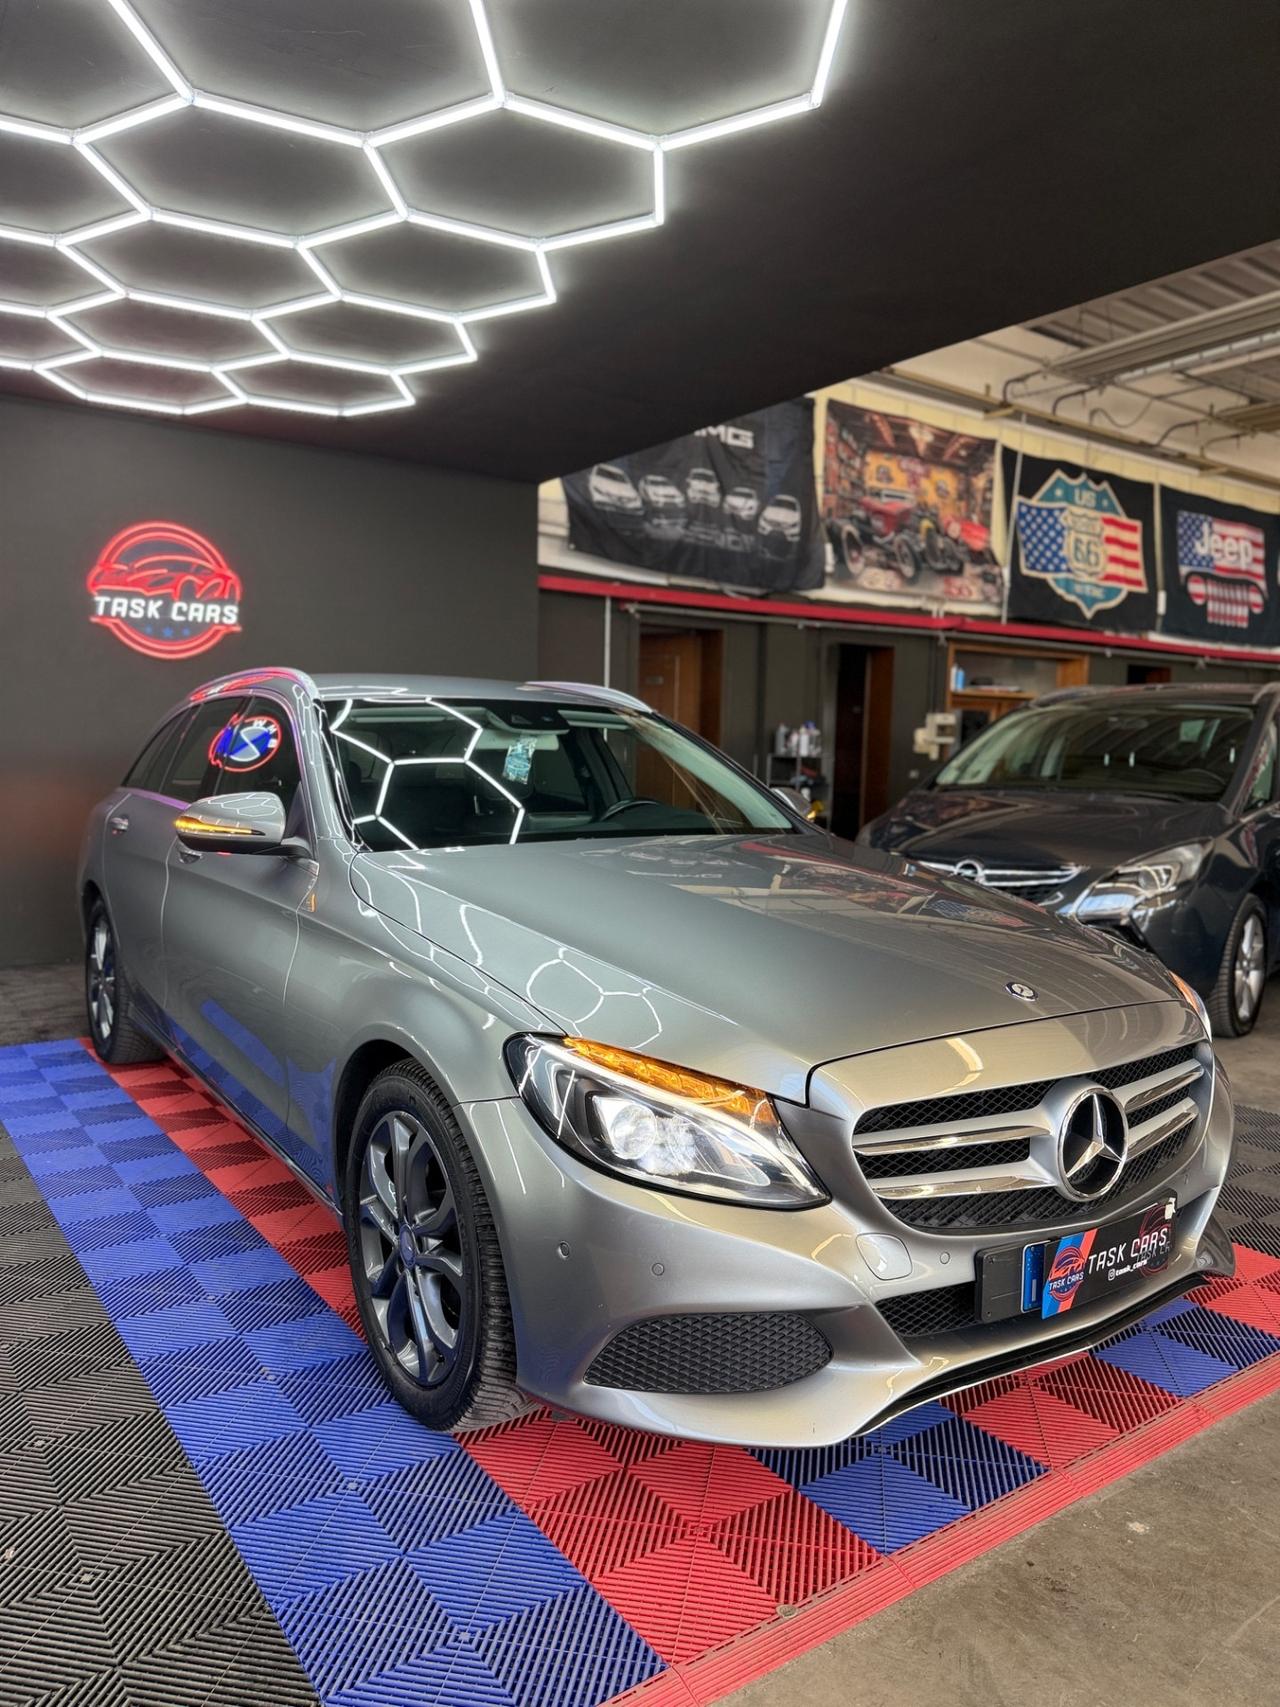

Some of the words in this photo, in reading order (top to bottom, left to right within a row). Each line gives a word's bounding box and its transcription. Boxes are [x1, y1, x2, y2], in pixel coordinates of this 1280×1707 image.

[1074, 488, 1096, 508] US
[1074, 537, 1100, 568] 66
[1194, 521, 1253, 571] Jeep
[94, 596, 164, 619] TASK
[171, 601, 239, 625] CARS
[1089, 1243, 1127, 1275] TASK
[1130, 1228, 1168, 1258] CARS
[1049, 1279, 1065, 1291] TASK
[1067, 1271, 1085, 1285] CARS
